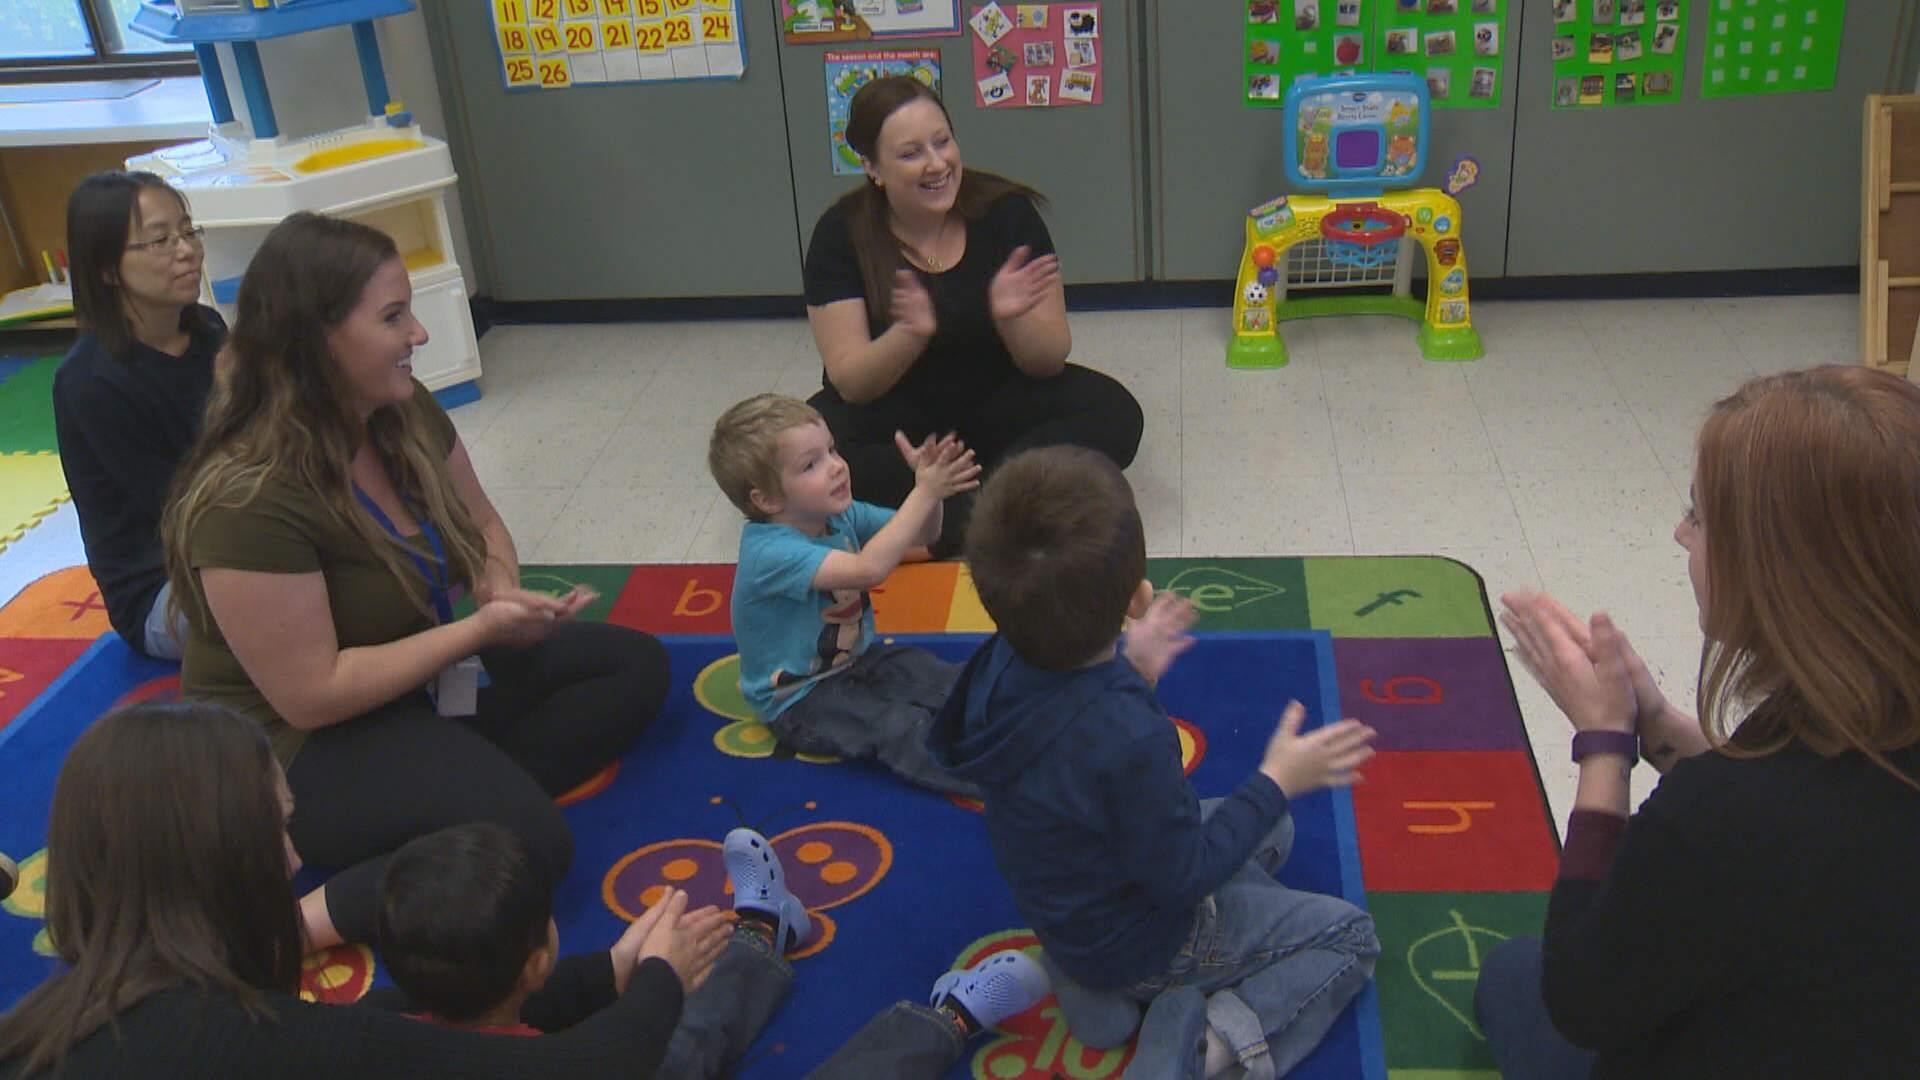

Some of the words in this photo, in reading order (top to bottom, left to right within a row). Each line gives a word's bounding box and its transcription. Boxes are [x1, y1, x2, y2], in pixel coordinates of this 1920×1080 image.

[503, 1, 518, 22] 11
[536, 0, 554, 19] 12
[569, 0, 589, 14] 13
[604, 0, 625, 15] 14
[639, 0, 659, 16] 15
[505, 29, 525, 50] 18
[534, 27, 558, 50] 19
[565, 27, 593, 48] 20
[607, 24, 630, 46] 21
[636, 28, 665, 50] 22
[664, 20, 691, 42] 23
[702, 16, 730, 38] 24
[827, 52, 841, 60] The
[883, 51, 897, 59] the
[897, 50, 921, 59] month
[506, 59, 534, 82] 25
[539, 63, 568, 84] 26
[61, 591, 107, 622] x
[672, 578, 723, 617] b
[1189, 581, 1236, 612] e
[1354, 588, 1423, 617] f
[1359, 675, 1443, 705] g
[1403, 800, 1496, 834] h
